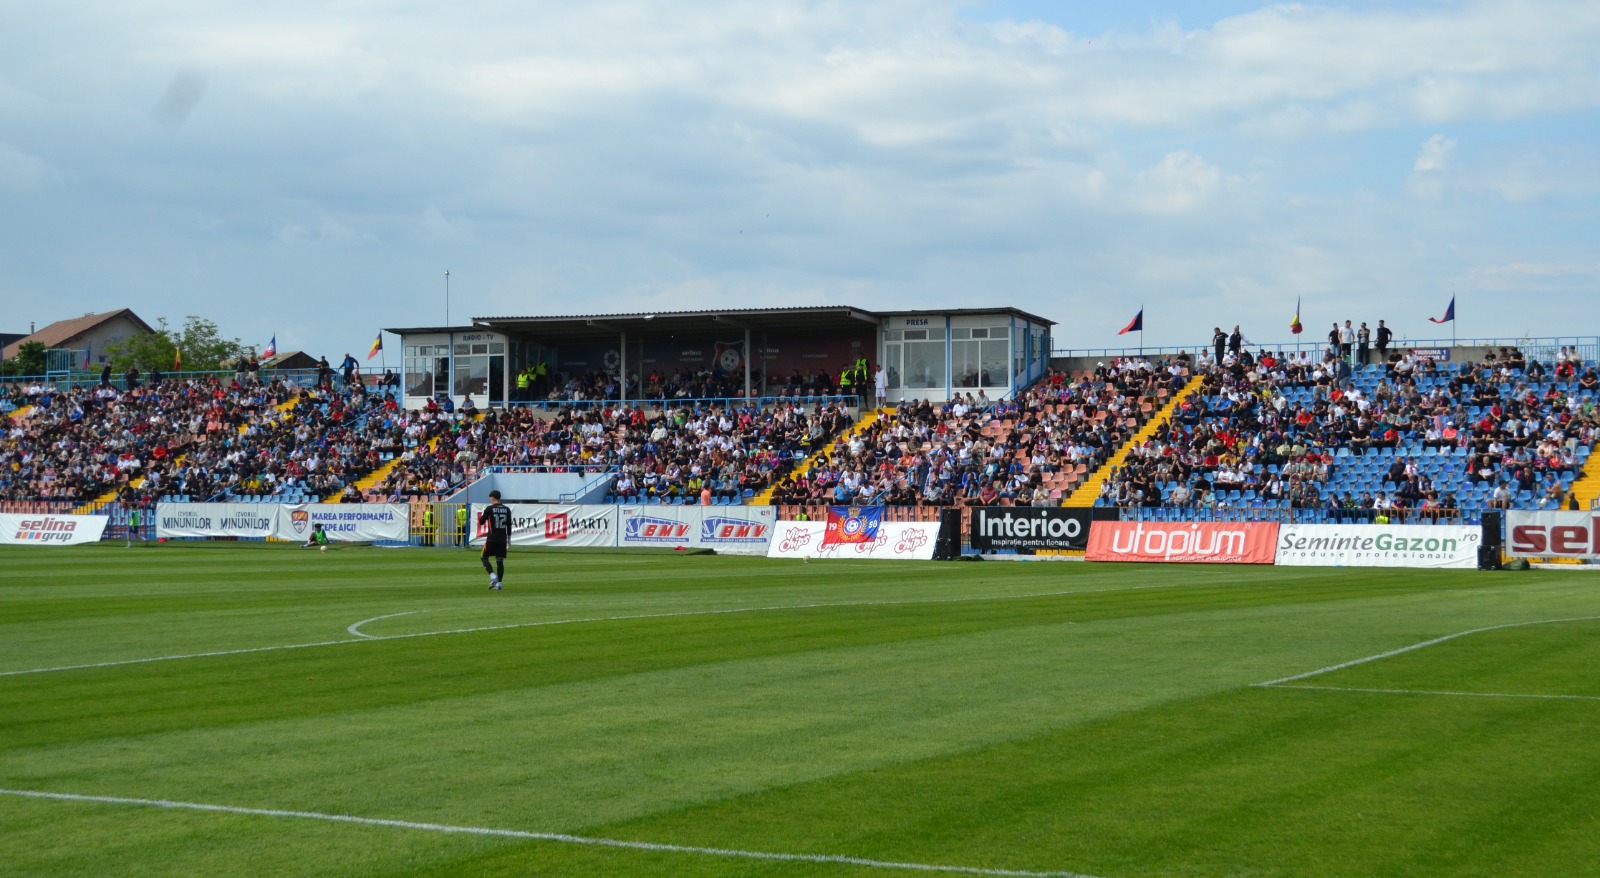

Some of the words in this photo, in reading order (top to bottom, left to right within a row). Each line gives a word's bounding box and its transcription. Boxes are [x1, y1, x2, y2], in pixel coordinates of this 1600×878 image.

[906, 318, 929, 326] PRESA
[311, 512, 337, 521] MAREA
[493, 514, 507, 529] 12
[510, 517, 540, 529] ARTY
[19, 517, 77, 531] selina
[162, 517, 212, 530] MINUNILOR
[220, 517, 271, 530] MINUNILOR
[311, 521, 337, 532] ÎEPE
[568, 517, 610, 530] MARTY
[828, 522, 838, 531] 19
[868, 519, 878, 529] 58
[979, 509, 1081, 538] Interioo
[40, 532, 73, 542] grup
[643, 524, 689, 537] BMV
[719, 525, 766, 538] BMV
[786, 526, 808, 540] Viva
[902, 528, 924, 541] Viva
[779, 534, 811, 552] Chips
[894, 536, 928, 554] Chips
[1022, 539, 1045, 547] pentru
[1112, 522, 1246, 560] utopium
[1282, 550, 1345, 558] Produse
[1355, 551, 1454, 559] profesionale
